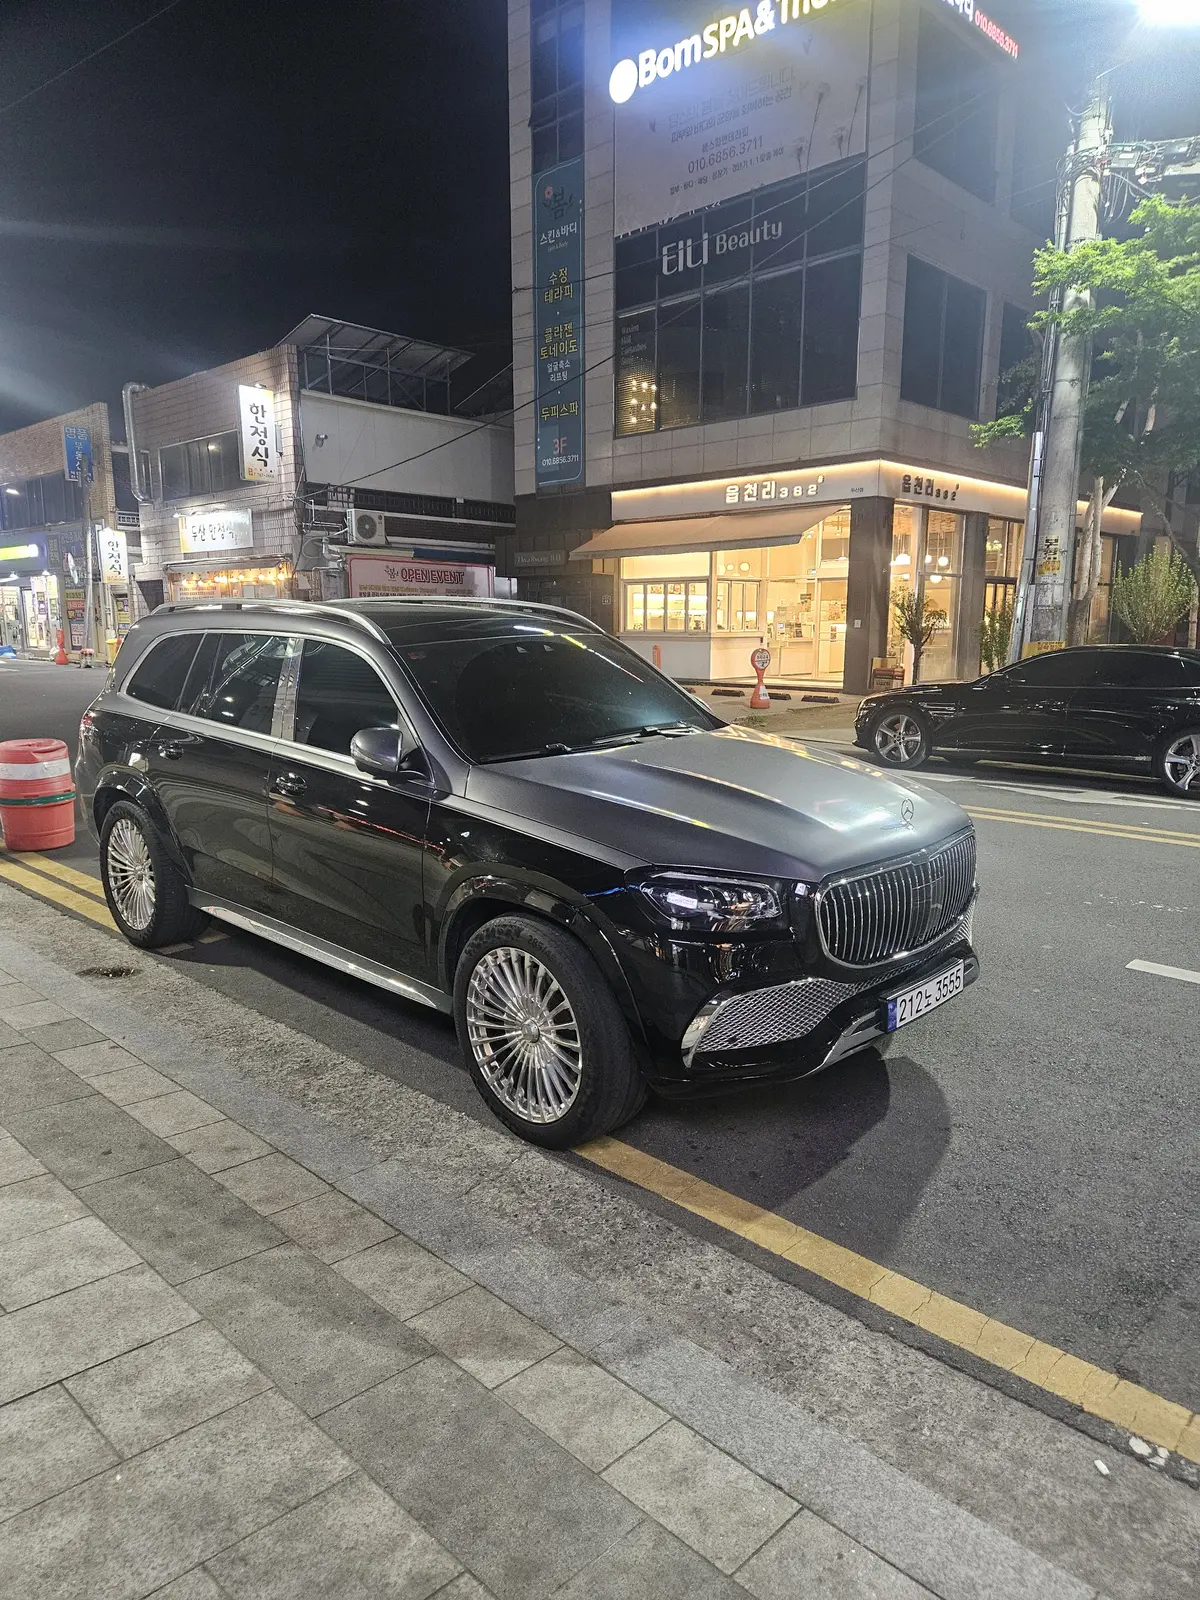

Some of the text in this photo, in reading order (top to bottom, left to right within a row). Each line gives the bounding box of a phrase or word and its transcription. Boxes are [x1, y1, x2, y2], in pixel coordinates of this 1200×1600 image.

[688, 135, 763, 174] 010.6856.3711
[716, 220, 783, 255] Beauty
[549, 267, 567, 285] 수정
[545, 283, 573, 303] 테라피
[545, 322, 573, 343] 콜라젠
[540, 340, 578, 359] 토네이도
[541, 401, 579, 421] 두피스파
[249, 403, 269, 467] 한정식
[553, 437, 567, 455] 3F
[542, 455, 579, 466] 010.6856.3711
[401, 568, 430, 583] OPEN
[430, 570, 465, 585] EVENT
[899, 968, 962, 1023] 212노 3555
